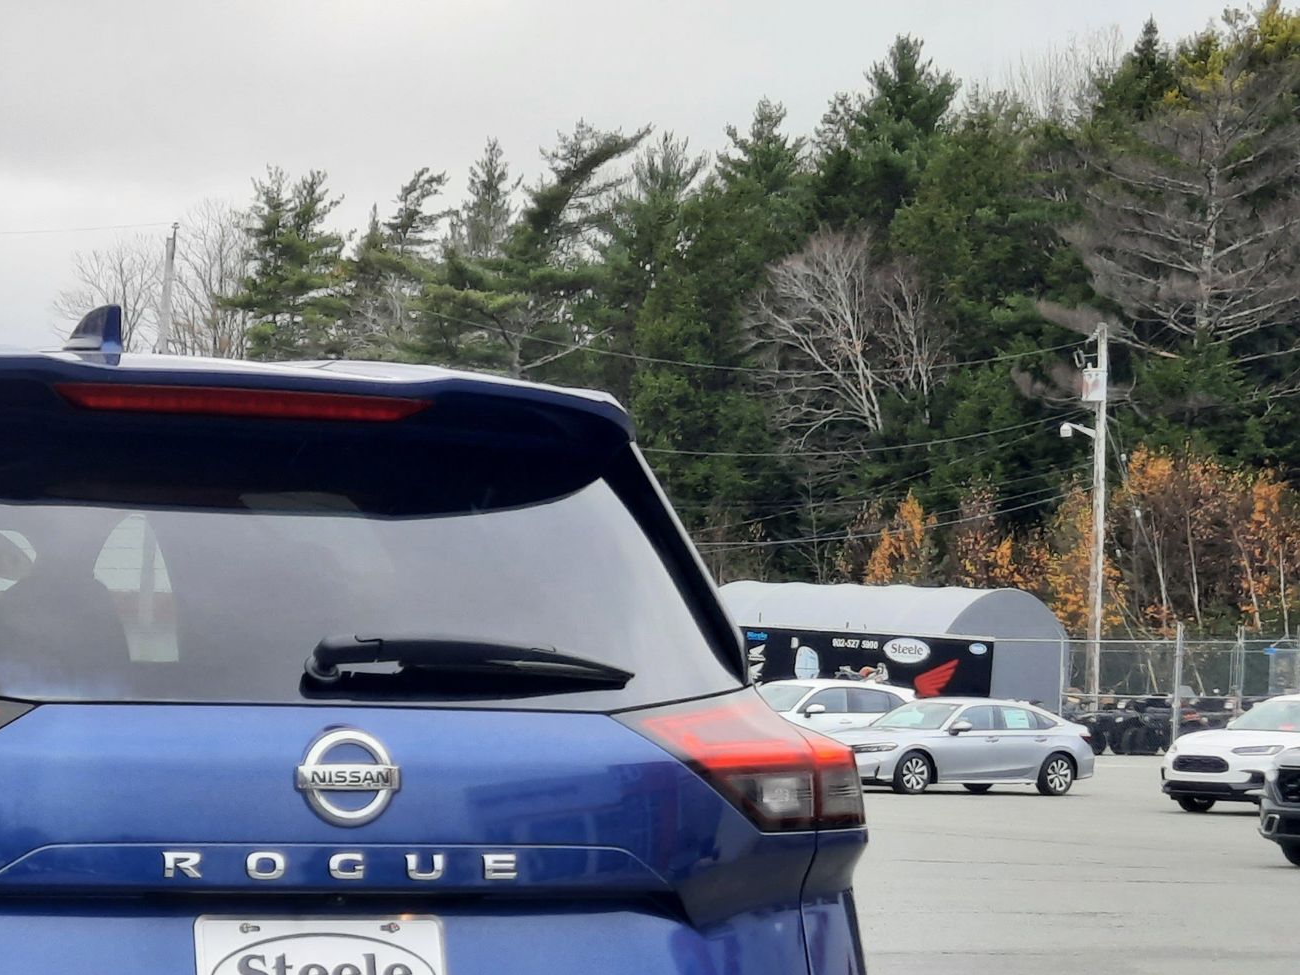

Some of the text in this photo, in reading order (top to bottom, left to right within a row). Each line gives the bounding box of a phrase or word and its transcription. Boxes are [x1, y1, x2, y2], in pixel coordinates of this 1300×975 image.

[891, 643, 924, 655] Steele
[310, 770, 390, 784] NISSAN
[161, 850, 518, 881] ROGUE
